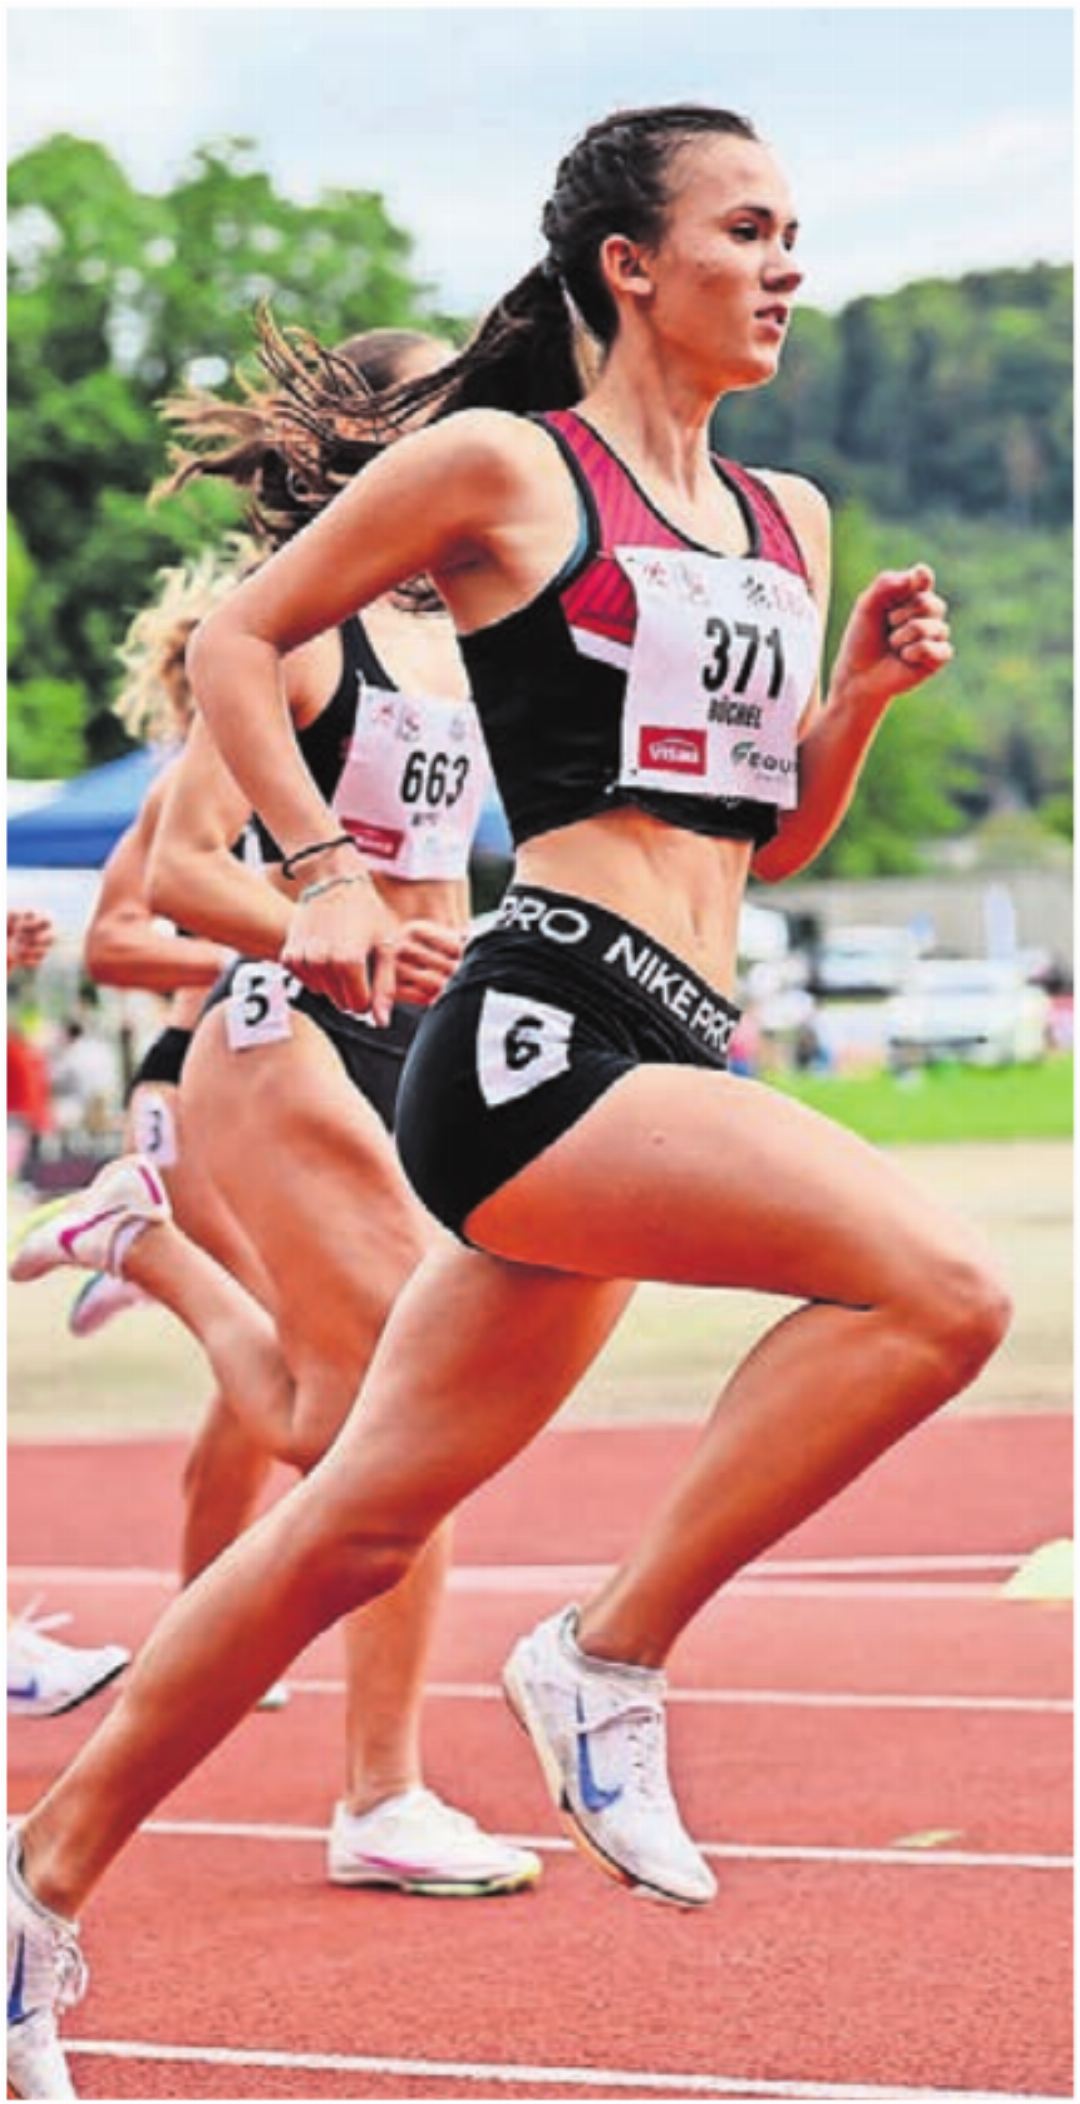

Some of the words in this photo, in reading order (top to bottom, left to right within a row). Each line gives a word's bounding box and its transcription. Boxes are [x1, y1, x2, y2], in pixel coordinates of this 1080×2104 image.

[702, 617, 785, 700] 371
[402, 751, 470, 808] 663
[243, 975, 270, 1027] 5
[602, 932, 700, 1021] NIKE
[503, 1013, 545, 1072] 6
[146, 1108, 164, 1152] 3
